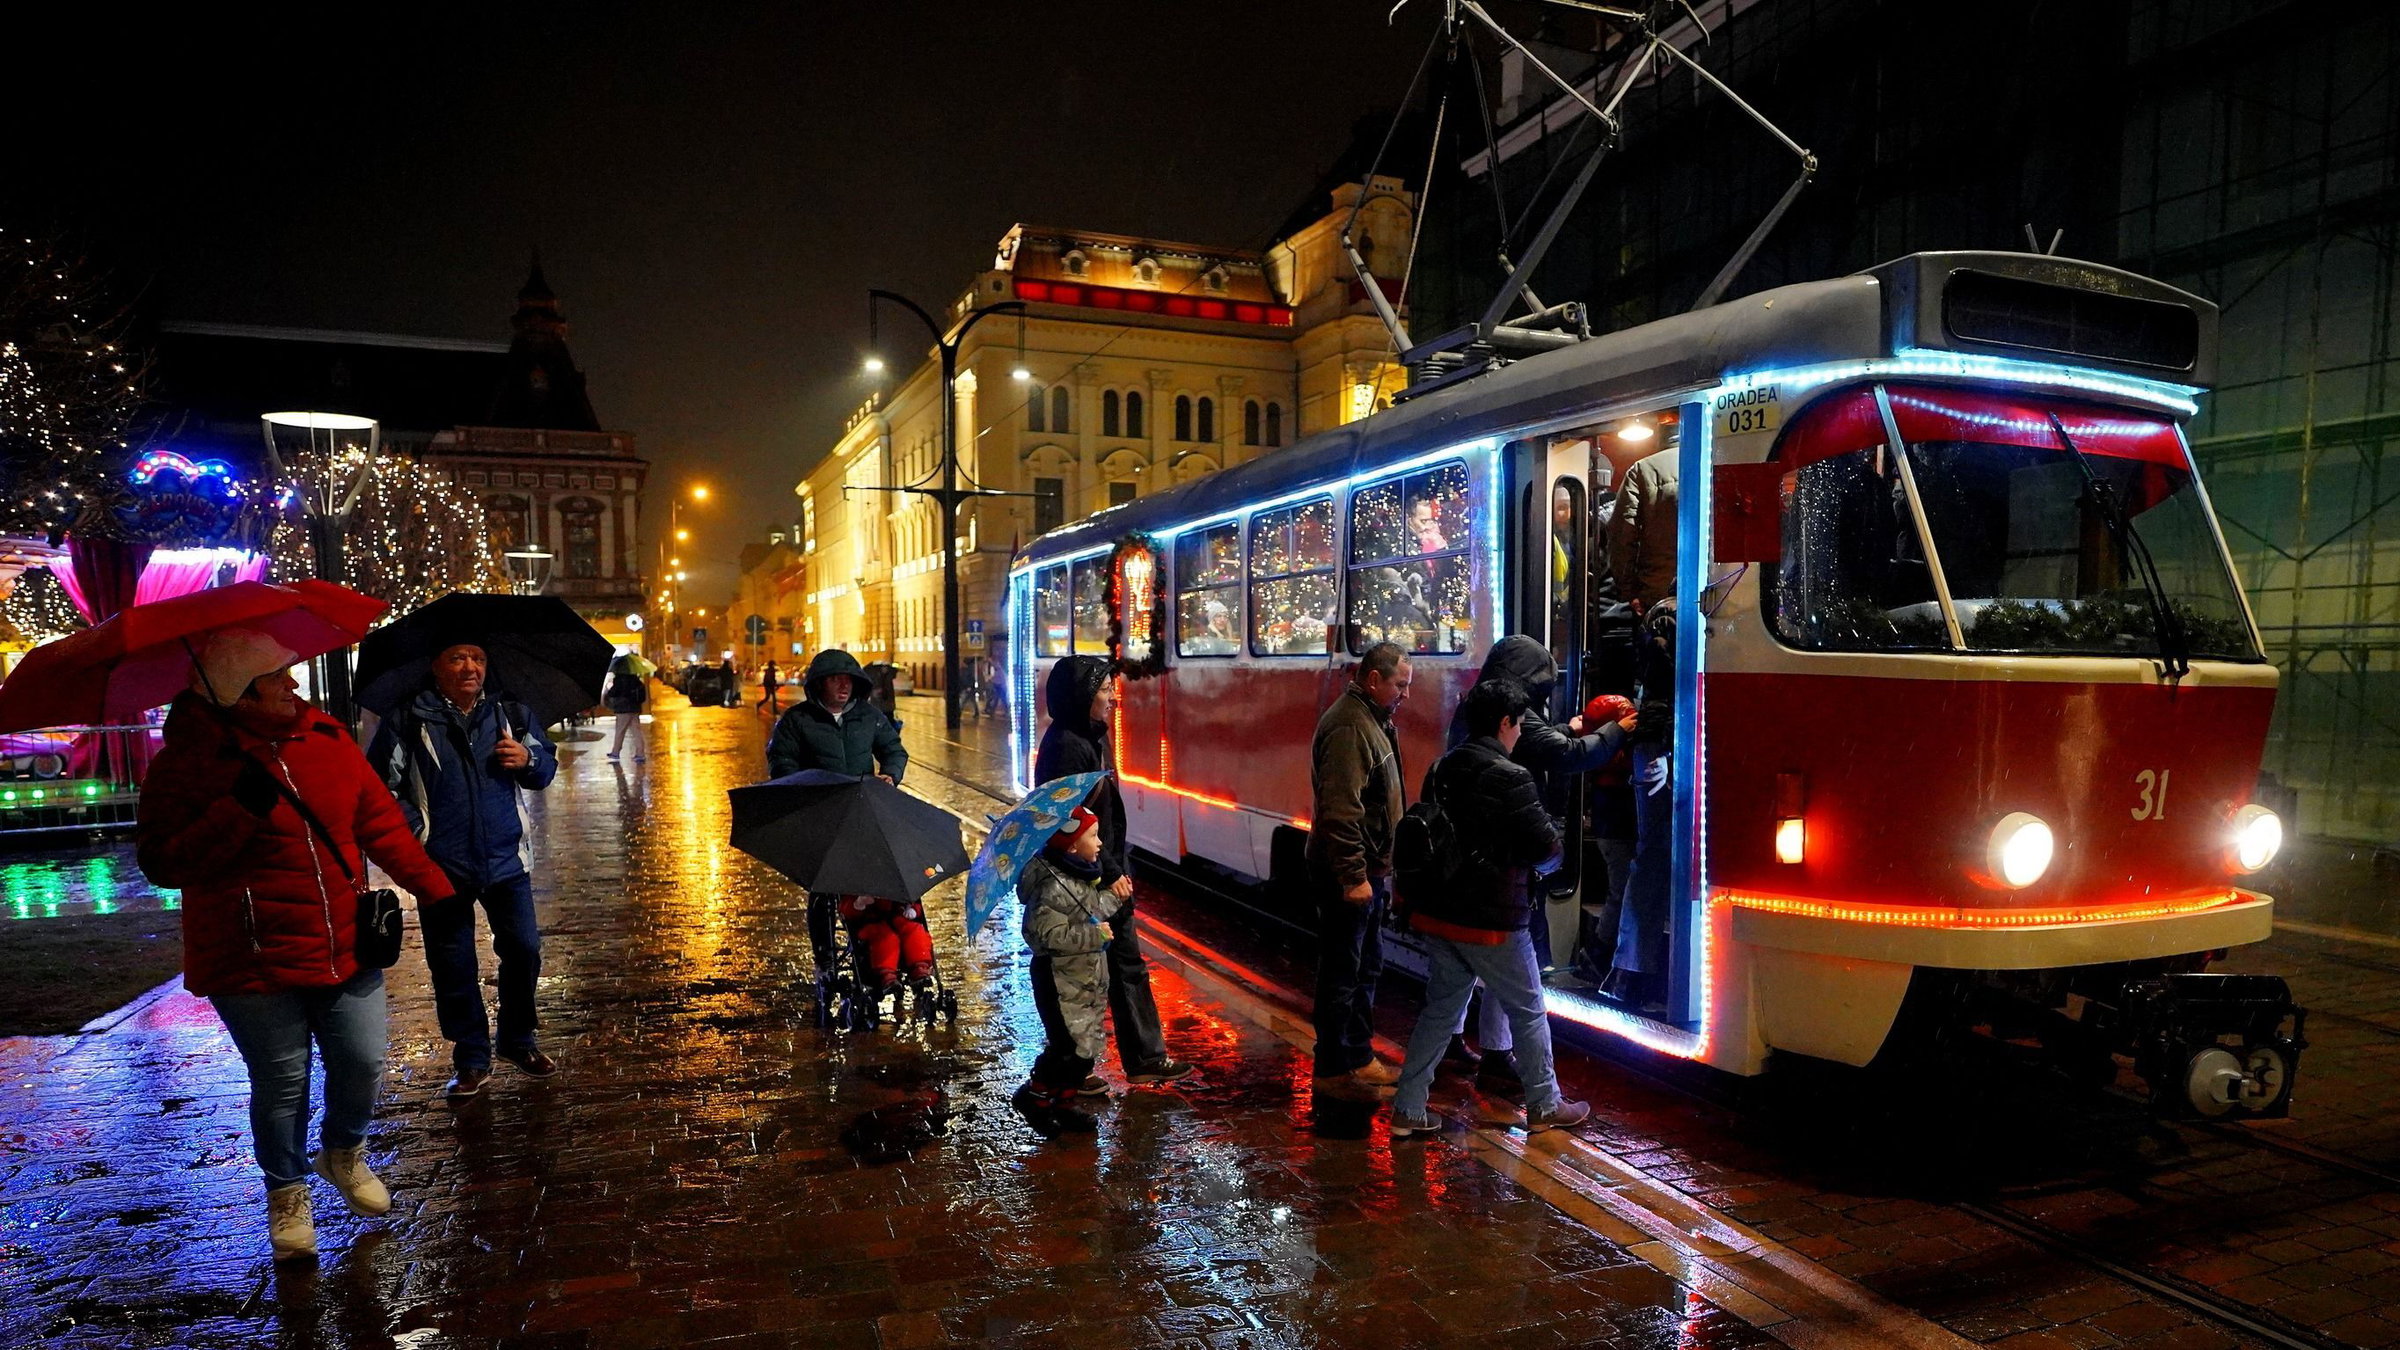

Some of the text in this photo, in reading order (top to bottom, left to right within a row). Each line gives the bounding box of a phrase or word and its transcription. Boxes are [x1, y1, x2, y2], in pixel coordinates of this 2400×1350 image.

[1717, 386, 1778, 410] ORADEA
[1729, 408, 1766, 433] 031
[2131, 769, 2169, 821] 31
